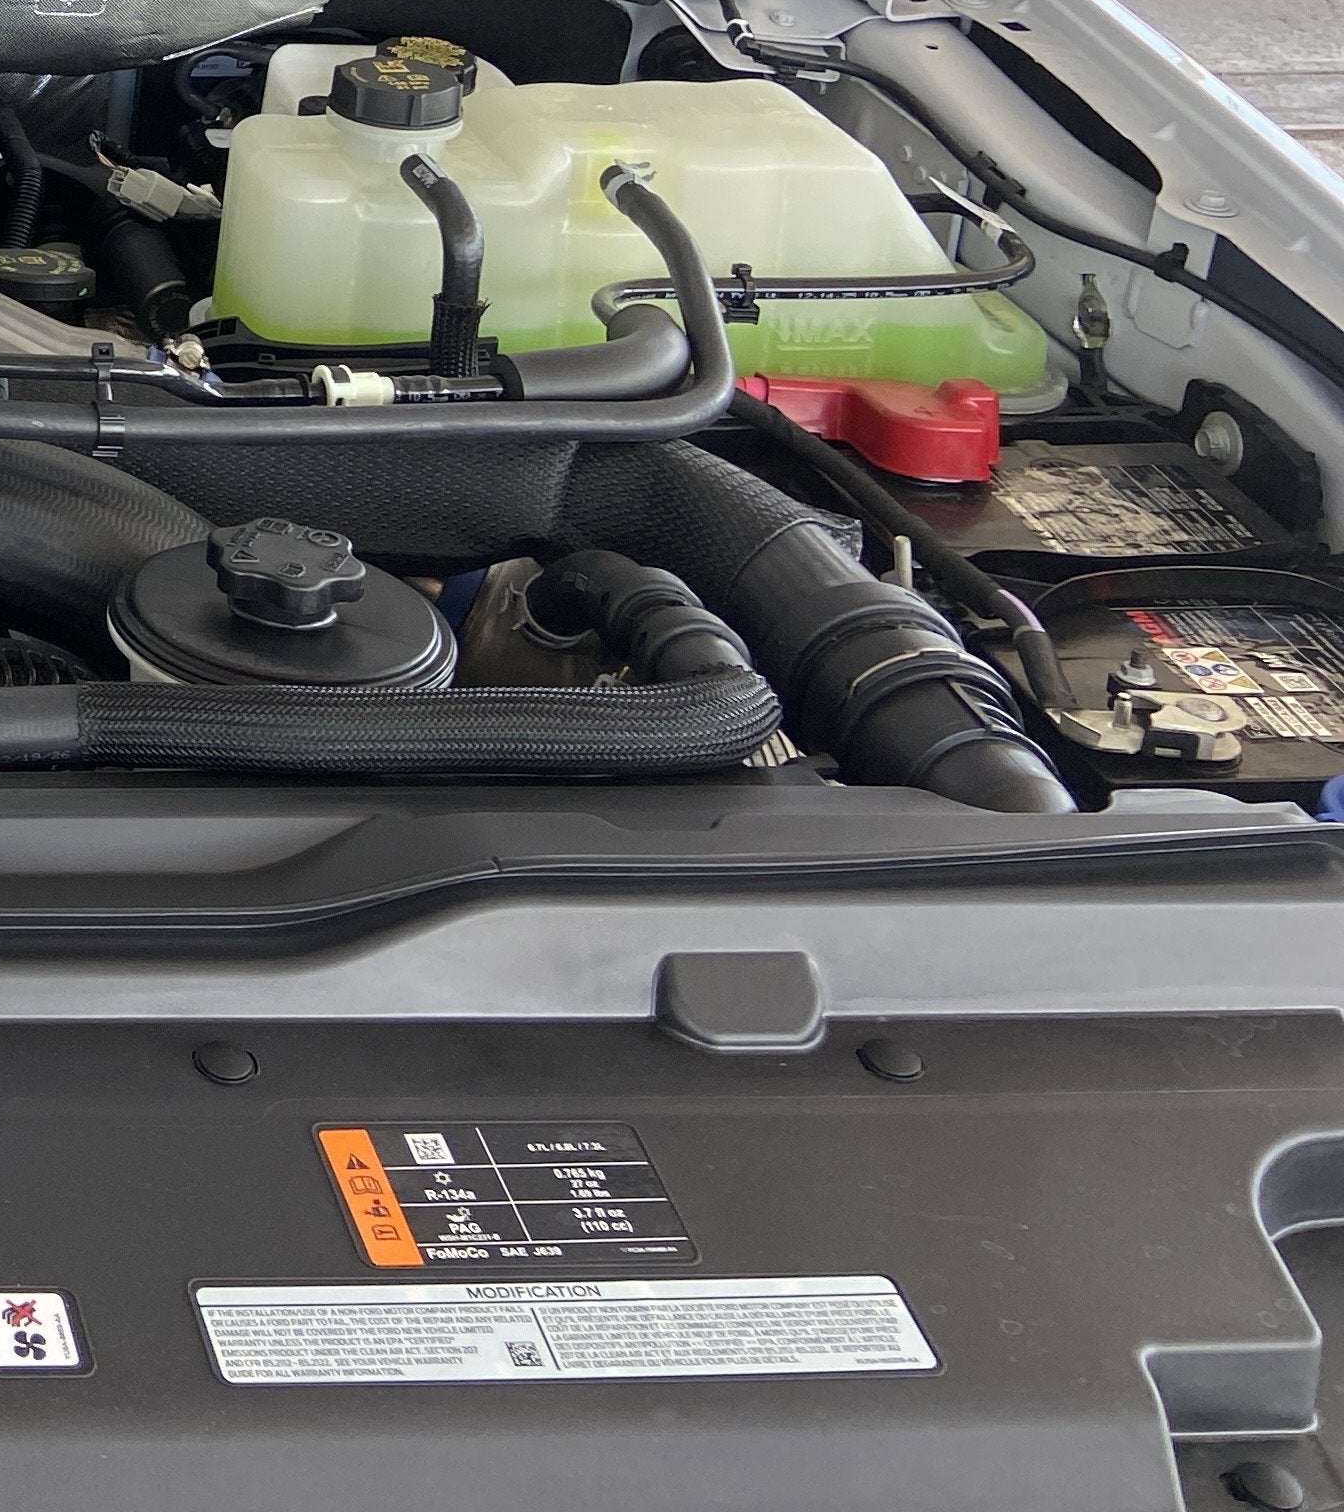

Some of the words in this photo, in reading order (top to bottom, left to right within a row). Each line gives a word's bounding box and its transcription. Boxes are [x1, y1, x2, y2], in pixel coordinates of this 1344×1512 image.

[553, 1168, 587, 1180] 0.765
[587, 1167, 607, 1181] kg
[423, 1188, 477, 1201] R-134a
[572, 1207, 593, 1219] 3.7
[594, 1207, 607, 1219] fl
[608, 1209, 626, 1218] oz
[448, 1222, 483, 1234] PAG
[580, 1220, 610, 1234] (110
[611, 1219, 634, 1233] cc)
[426, 1247, 490, 1260] FoMoCo
[499, 1246, 529, 1257] SAE
[533, 1246, 563, 1257] J639
[466, 1284, 602, 1300] MODIFICATION
